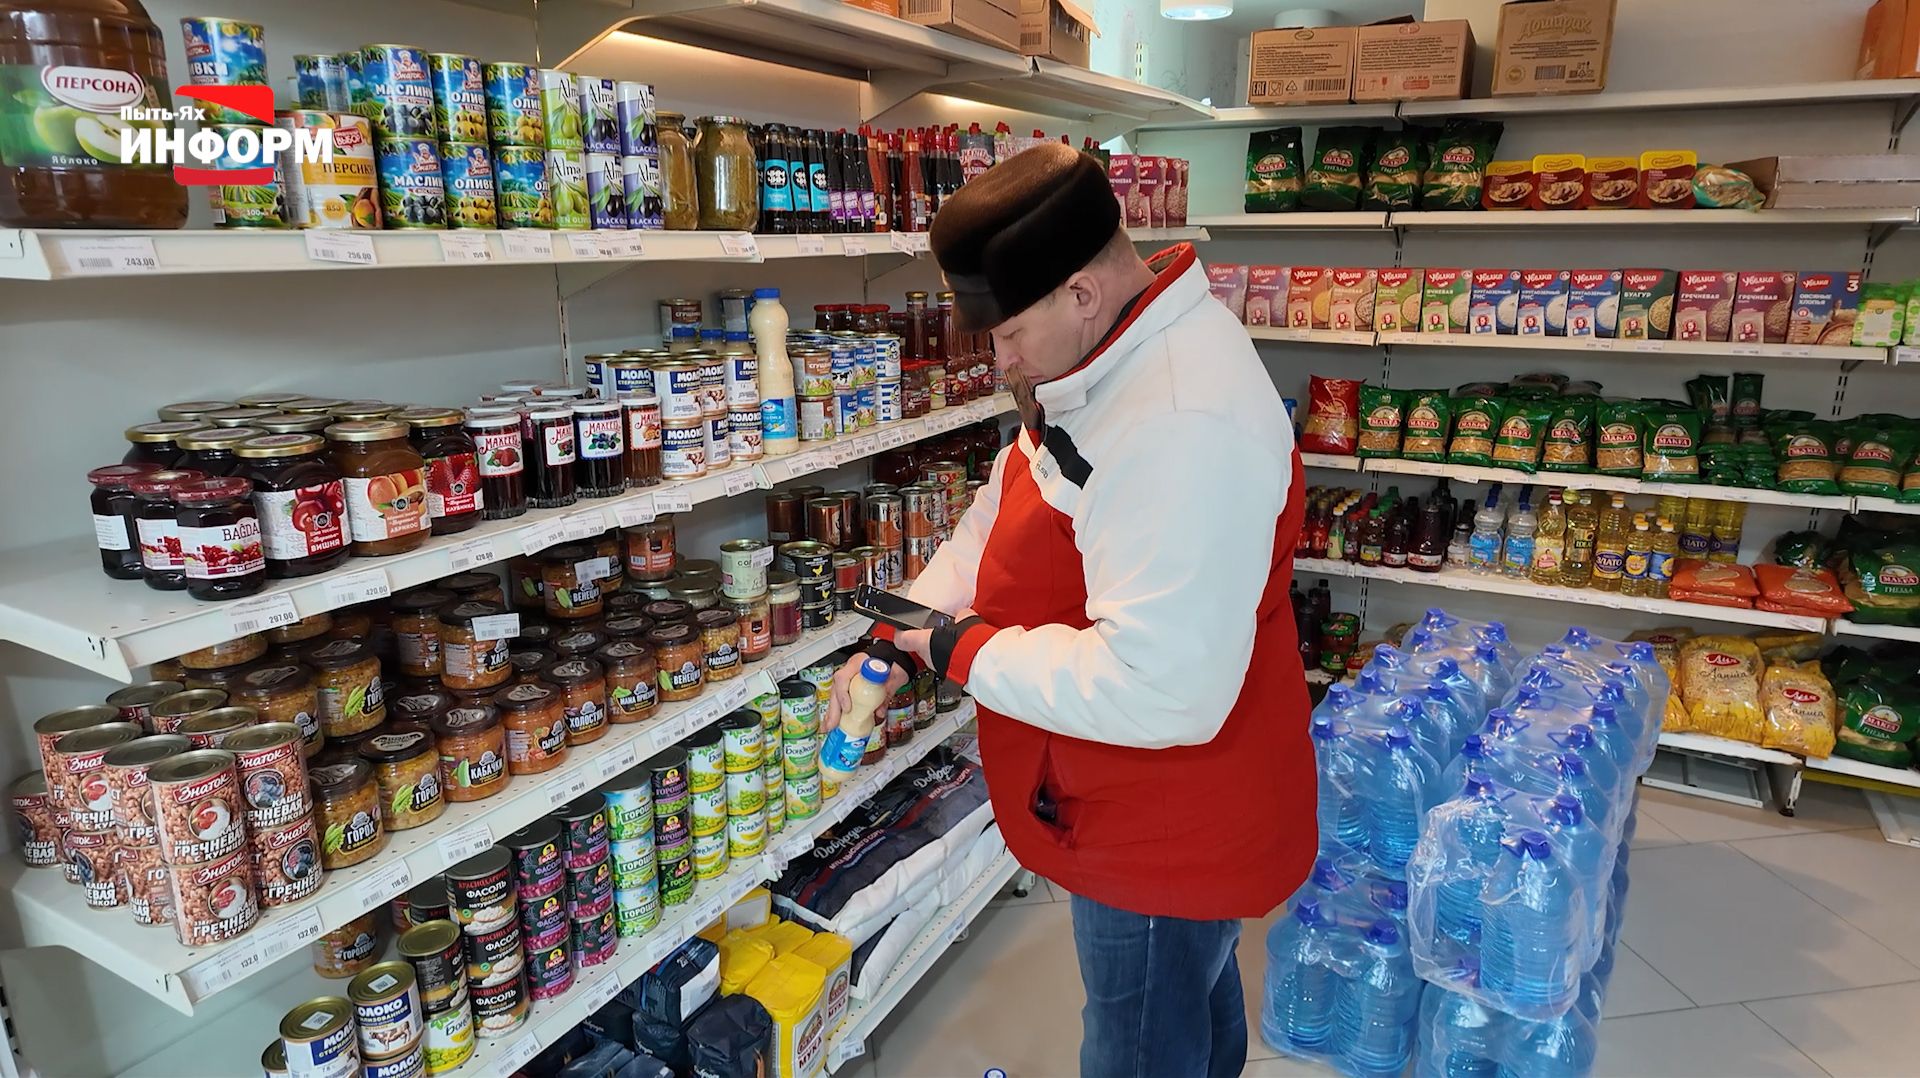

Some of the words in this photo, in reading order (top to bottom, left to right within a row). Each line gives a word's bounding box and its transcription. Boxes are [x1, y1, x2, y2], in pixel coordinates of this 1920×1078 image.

[1517, 16, 1592, 42] Доширак
[55, 75, 137, 95] ПЕРСОНА
[51, 155, 98, 165] Яблоко
[125, 257, 155, 266] 243.00
[1847, 279, 1859, 292] 3
[1623, 291, 1652, 299] БУЛГУР
[1680, 292, 1720, 300] ГРЕЧНЕВАЯ
[1738, 293, 1778, 301] ГРЕЧНЕВАЯ
[1658, 437, 1690, 446] MAKFA
[390, 521, 418, 533] АБРИКОС
[310, 538, 341, 552] ВИШНЯ
[1596, 557, 1623, 566] ЗЛАТО
[1881, 575, 1918, 584] MAKFA
[268, 611, 294, 625] 297.00
[238, 749, 285, 770] Знаток
[470, 756, 503, 780] КАБАЧКИ
[179, 773, 228, 802] Знаток
[415, 785, 438, 804] ГОРОХ
[272, 791, 303, 807] КАША
[346, 821, 375, 845] ГОРОХ
[198, 852, 242, 884] Знаток
[465, 880, 507, 899] ФАСОЛЬ
[297, 924, 319, 940] 132.00
[485, 928, 519, 951] ФАСОЛЬ
[475, 988, 517, 1006] ФАСОЛЬ
[798, 1036, 823, 1069] МУКА
